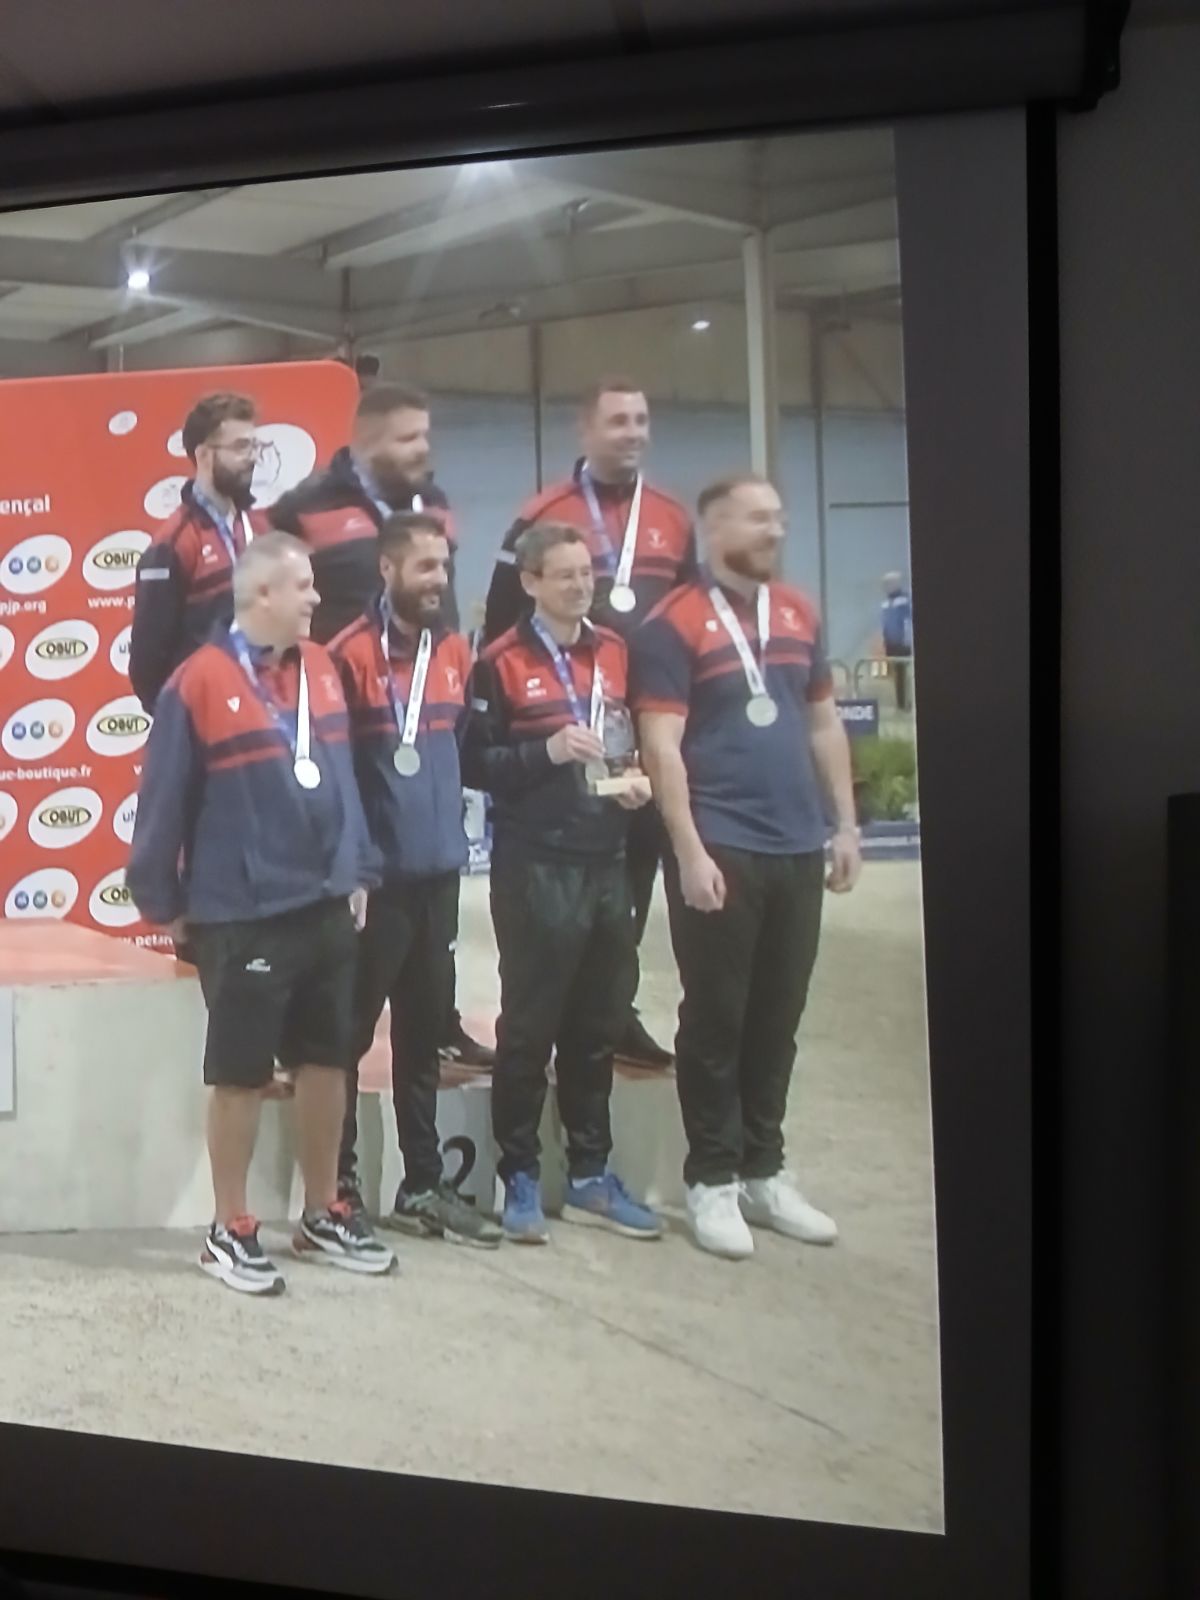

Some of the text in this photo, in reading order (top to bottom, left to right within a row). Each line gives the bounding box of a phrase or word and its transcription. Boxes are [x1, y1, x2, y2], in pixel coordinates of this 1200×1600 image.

[46, 640, 78, 655] OBUT
[107, 718, 139, 733] OBUT
[49, 809, 81, 824] OBUT
[442, 1134, 477, 1206] 2
